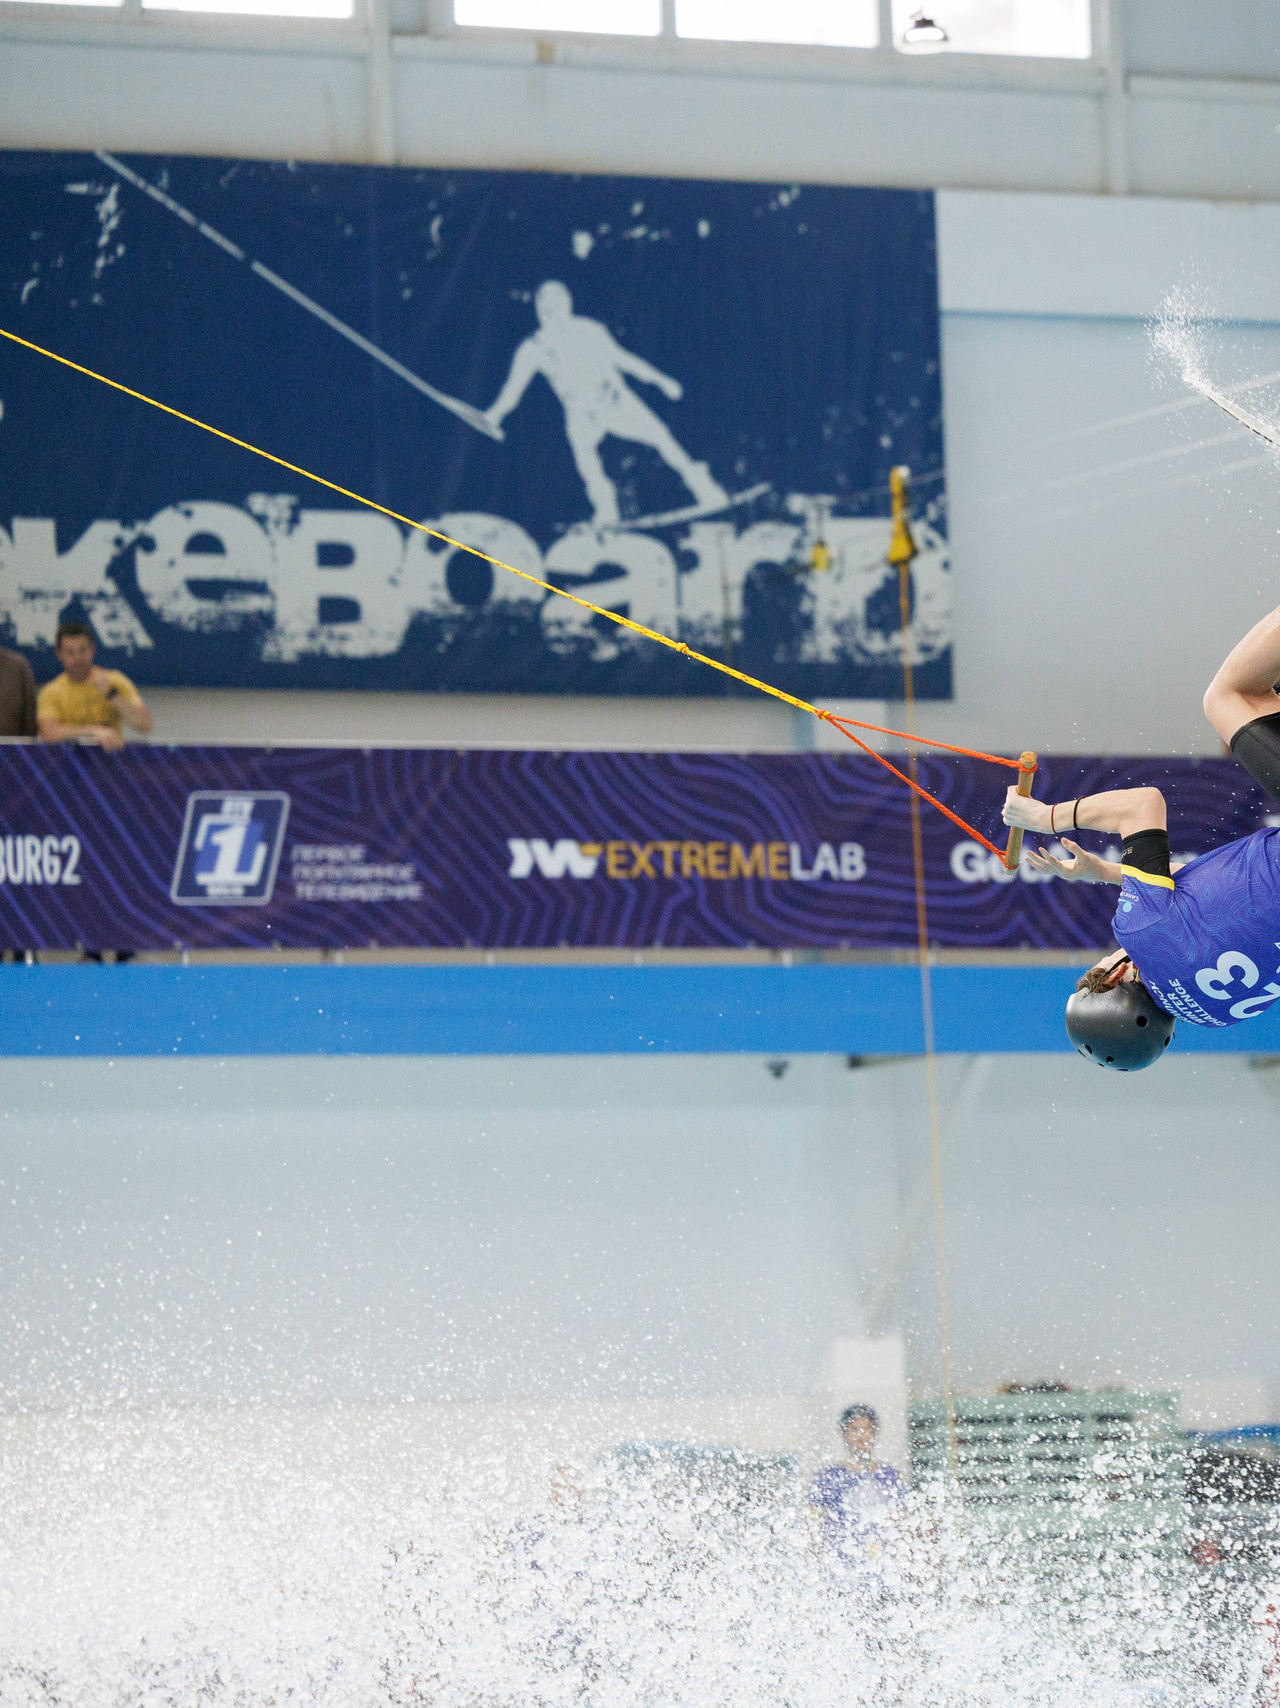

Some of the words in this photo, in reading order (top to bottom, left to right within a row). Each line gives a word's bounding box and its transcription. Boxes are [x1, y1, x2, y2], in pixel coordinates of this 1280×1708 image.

[605, 840, 867, 881] EXTREMELAB
[1167, 992, 1206, 1025] WINTER
[1169, 978, 1228, 1027] CHALLENGE
